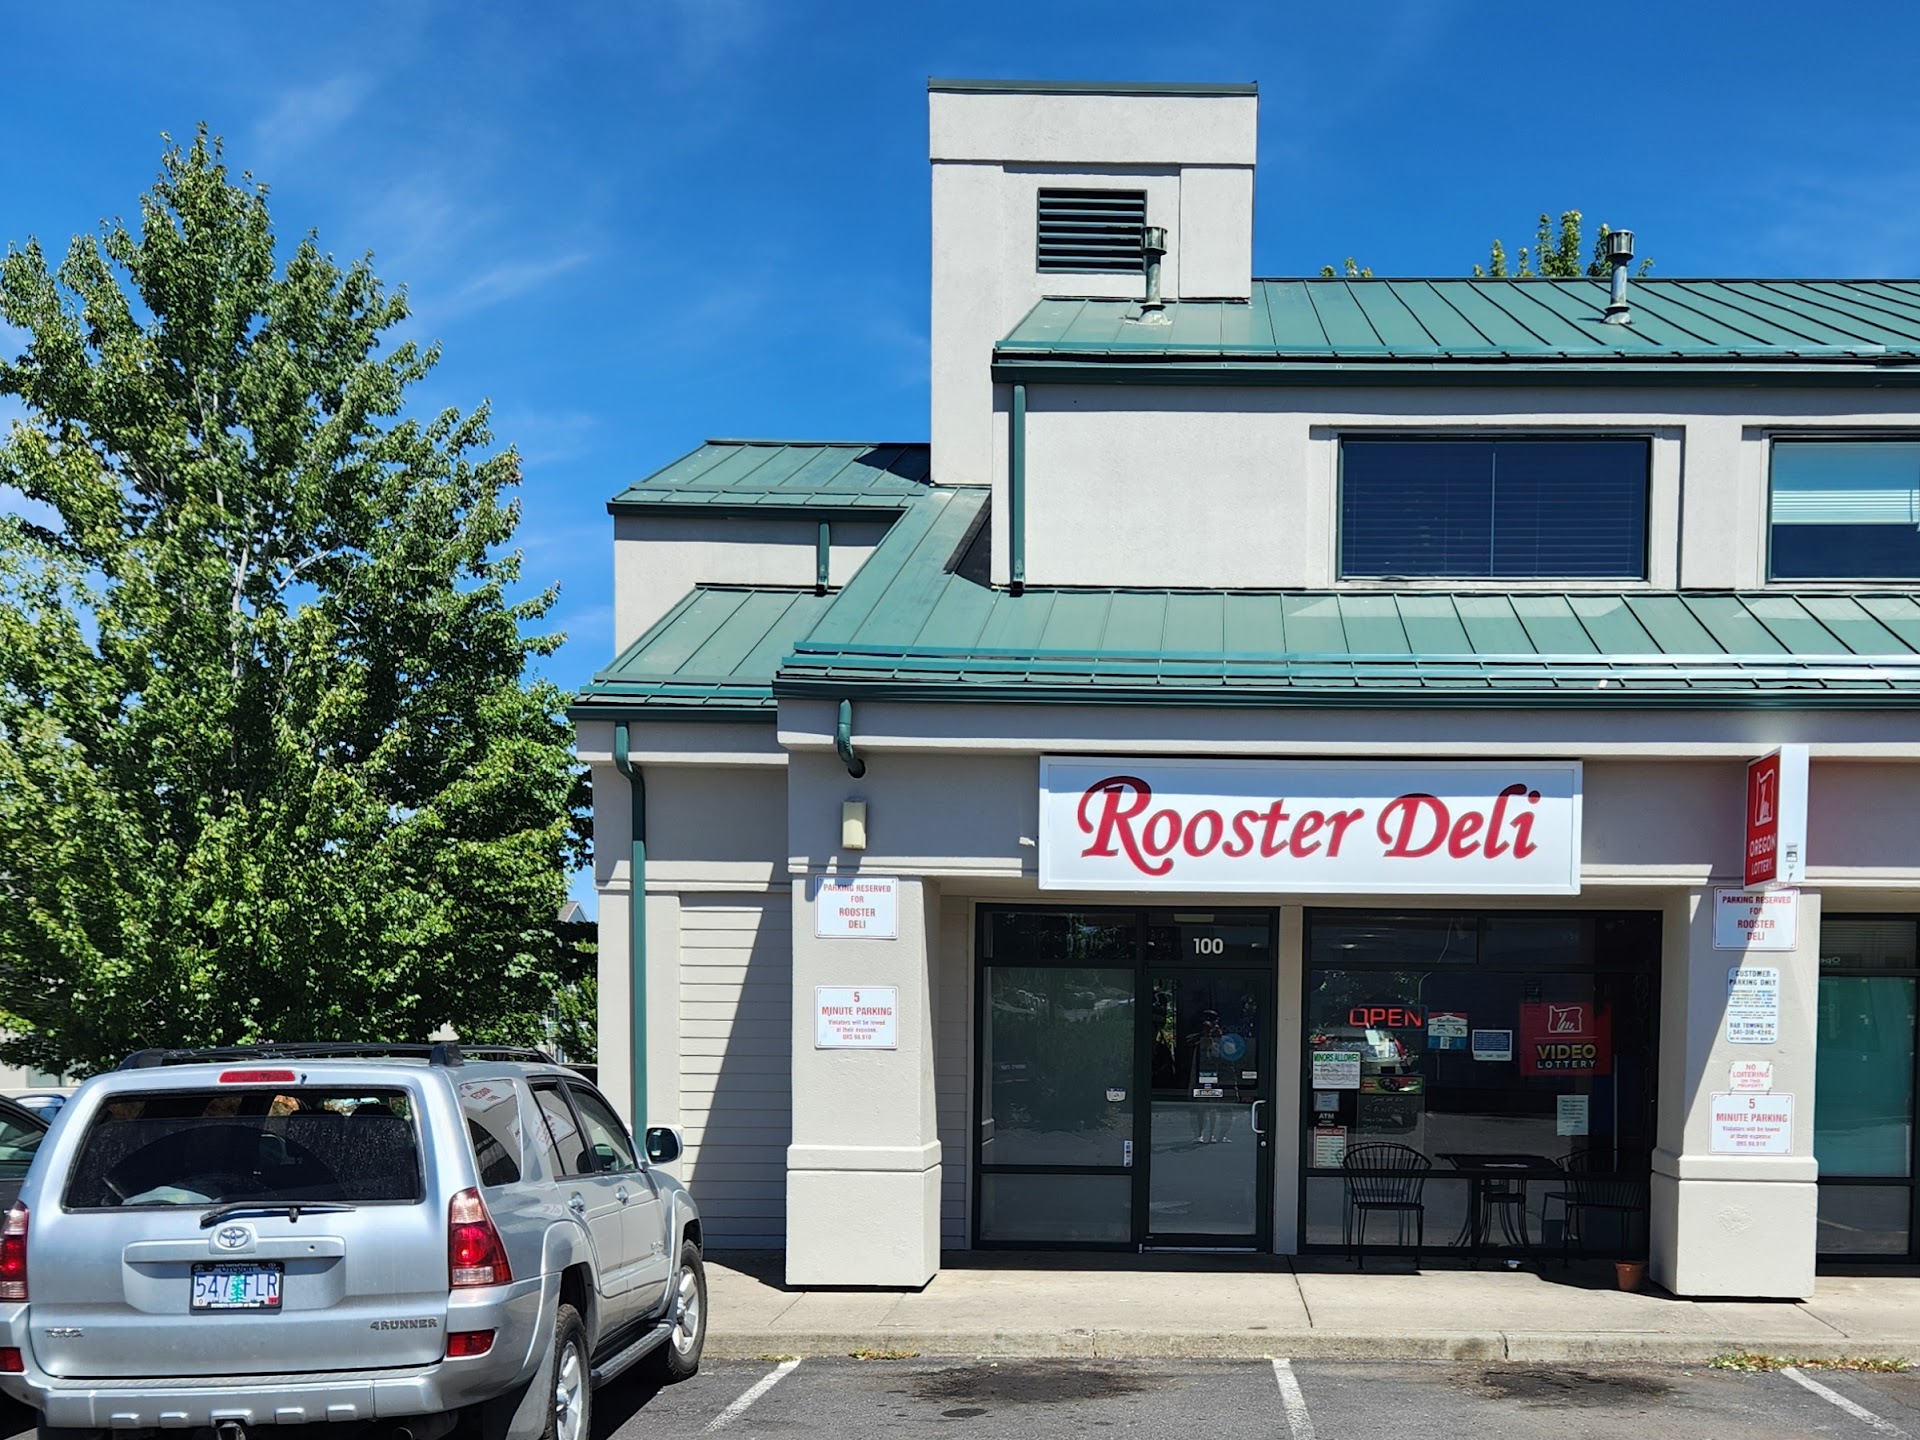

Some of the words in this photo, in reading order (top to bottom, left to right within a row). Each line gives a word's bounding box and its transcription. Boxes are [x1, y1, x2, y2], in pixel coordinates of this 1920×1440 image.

[1077, 775, 1364, 877] Rooster
[1377, 783, 1541, 860] Deli
[1749, 833, 1776, 858] OREGON
[823, 883, 854, 892] PARKING
[856, 884, 891, 893] RESERVED
[850, 895, 864, 903] FOR
[1722, 896, 1754, 904] PARKING
[1755, 896, 1792, 904] RESERVED
[839, 907, 876, 917] ROOSTER
[1749, 907, 1763, 915] FOR
[848, 920, 866, 929] DELI
[1737, 919, 1775, 929] ROOSTER
[1746, 932, 1765, 941] DELI
[1193, 937, 1224, 955] 100
[1735, 970, 1771, 978] CUSTOMER
[853, 991, 860, 1003] 5
[821, 1006, 854, 1015] MINUTE
[856, 1006, 892, 1016] PARKING
[1350, 1008, 1422, 1027] OPEN
[1536, 1044, 1597, 1060] VIDEO
[1314, 1053, 1334, 1062] MINORS
[1335, 1053, 1359, 1062] ALLOWED
[1537, 1060, 1596, 1069] LOTTERY
[1748, 1098, 1756, 1109] 5
[1716, 1113, 1748, 1122] MINUTE
[1751, 1113, 1788, 1123] PARKING
[195, 1273, 231, 1298] 547
[243, 1272, 279, 1297] FLR
[370, 1318, 438, 1331] 4RUNNER
